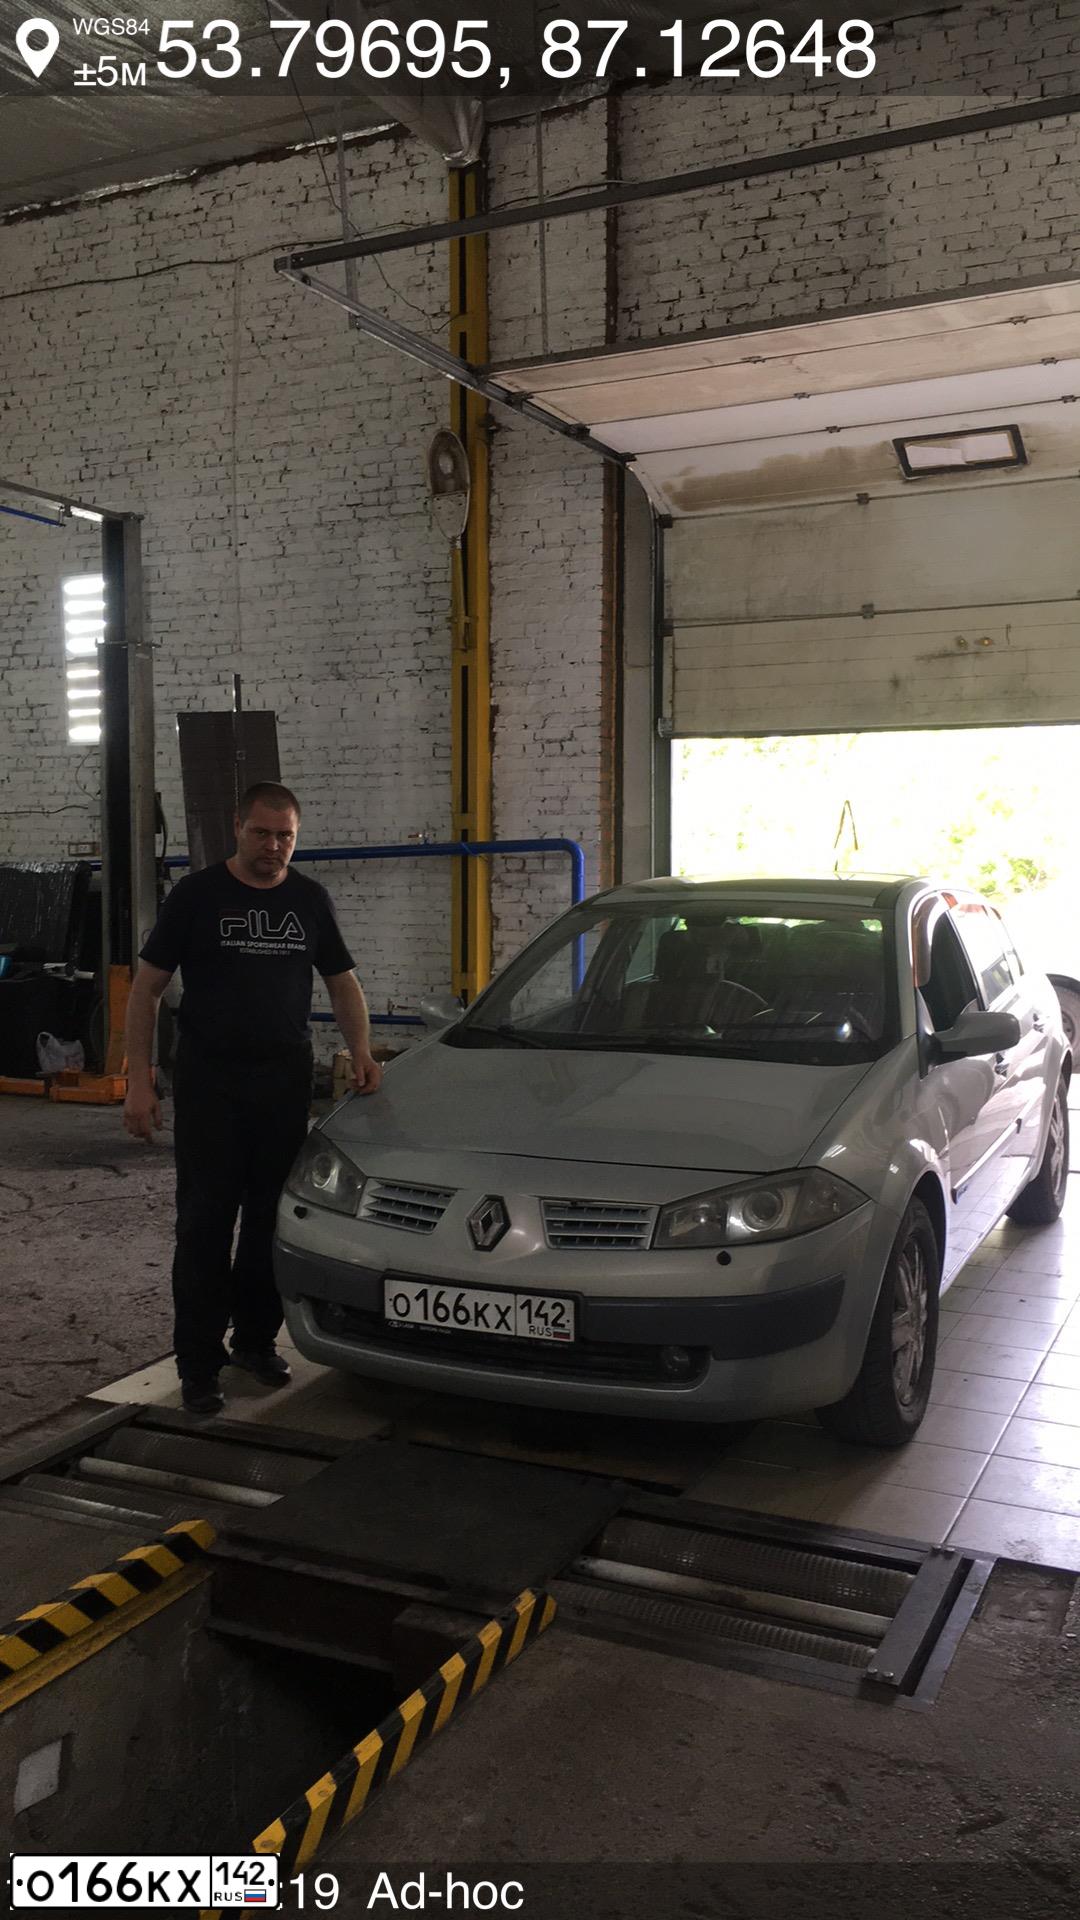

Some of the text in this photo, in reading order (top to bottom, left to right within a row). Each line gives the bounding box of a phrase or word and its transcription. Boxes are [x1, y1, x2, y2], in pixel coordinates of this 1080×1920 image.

[220, 910, 305, 941] FILA
[519, 1298, 566, 1328] 142
[528, 1325, 553, 1338] RUS
